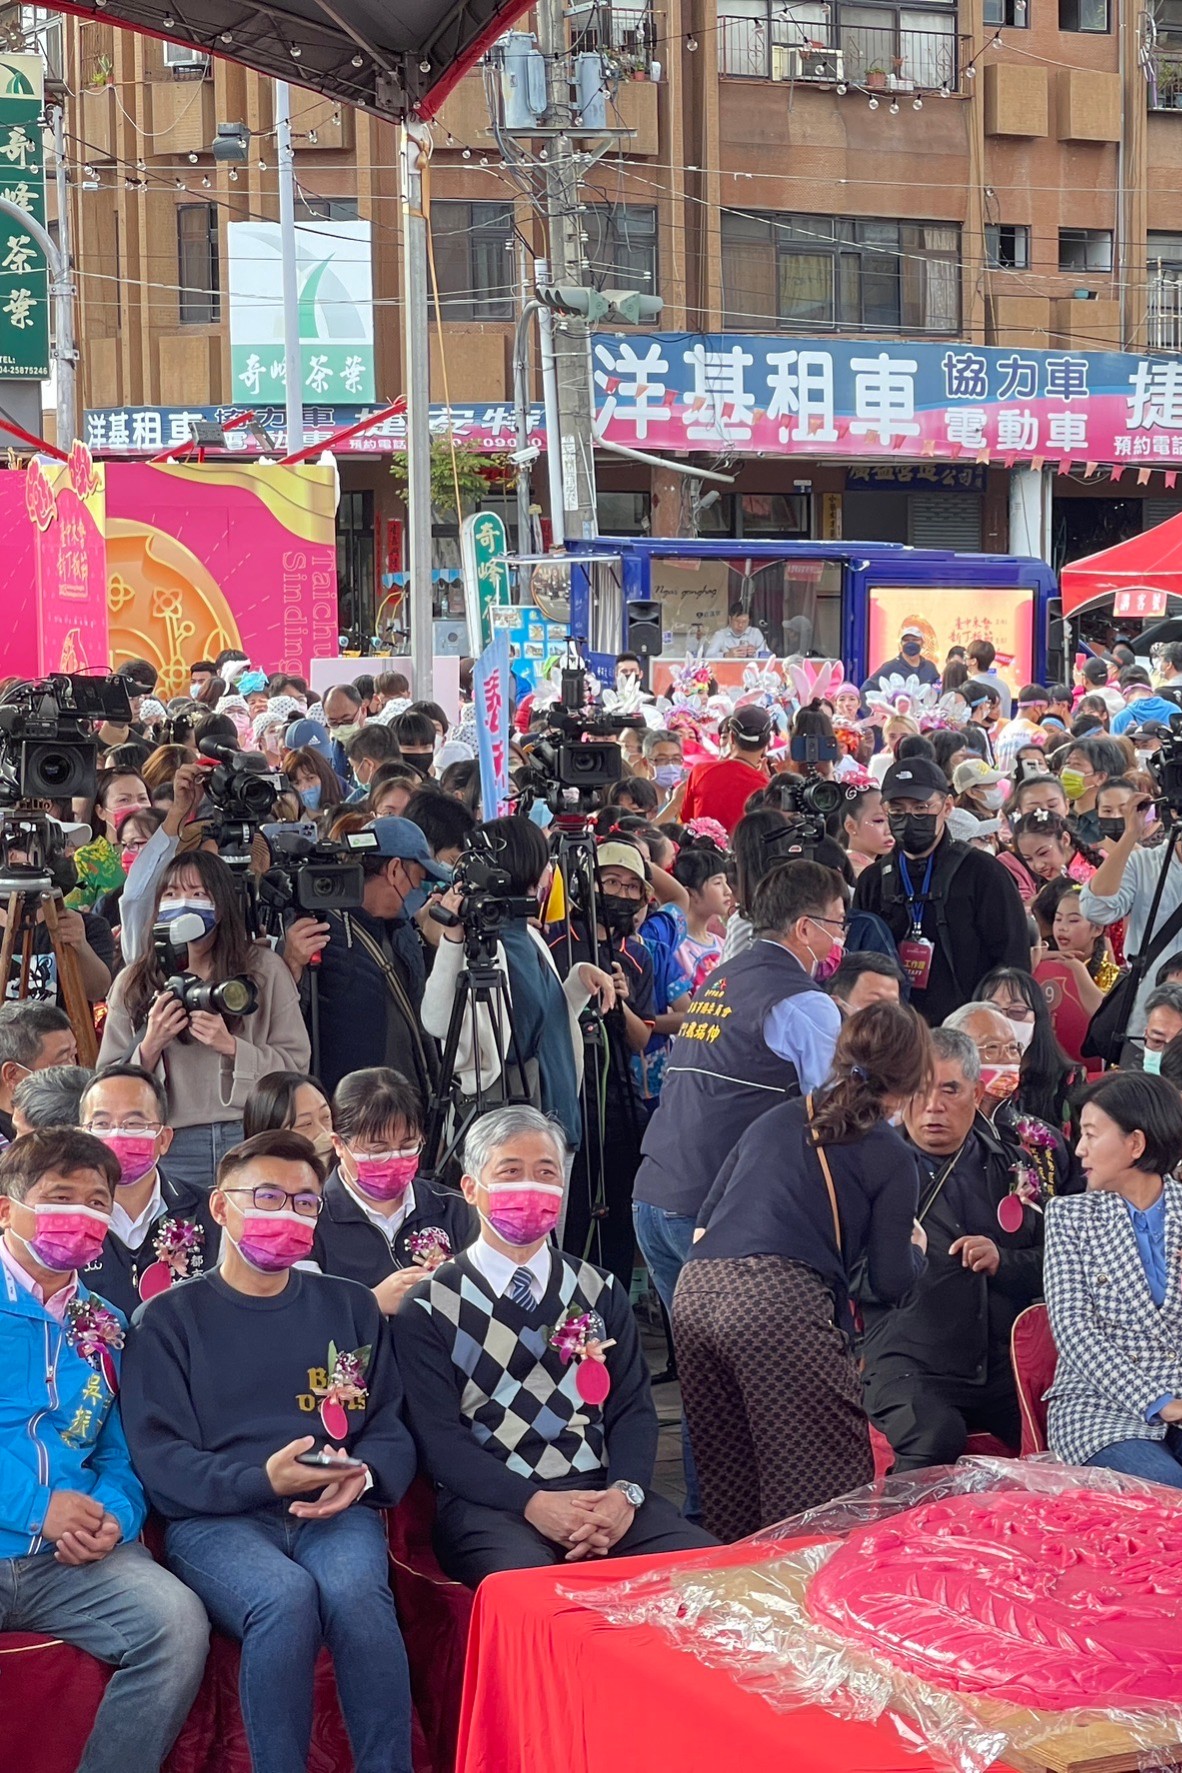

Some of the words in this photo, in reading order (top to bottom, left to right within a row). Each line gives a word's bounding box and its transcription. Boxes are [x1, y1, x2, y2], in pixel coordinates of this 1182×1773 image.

[592, 343, 921, 447] 洋基租車
[942, 352, 1089, 402] 協力車
[88, 413, 204, 449] 洋基租車
[944, 407, 1089, 452] 電動車
